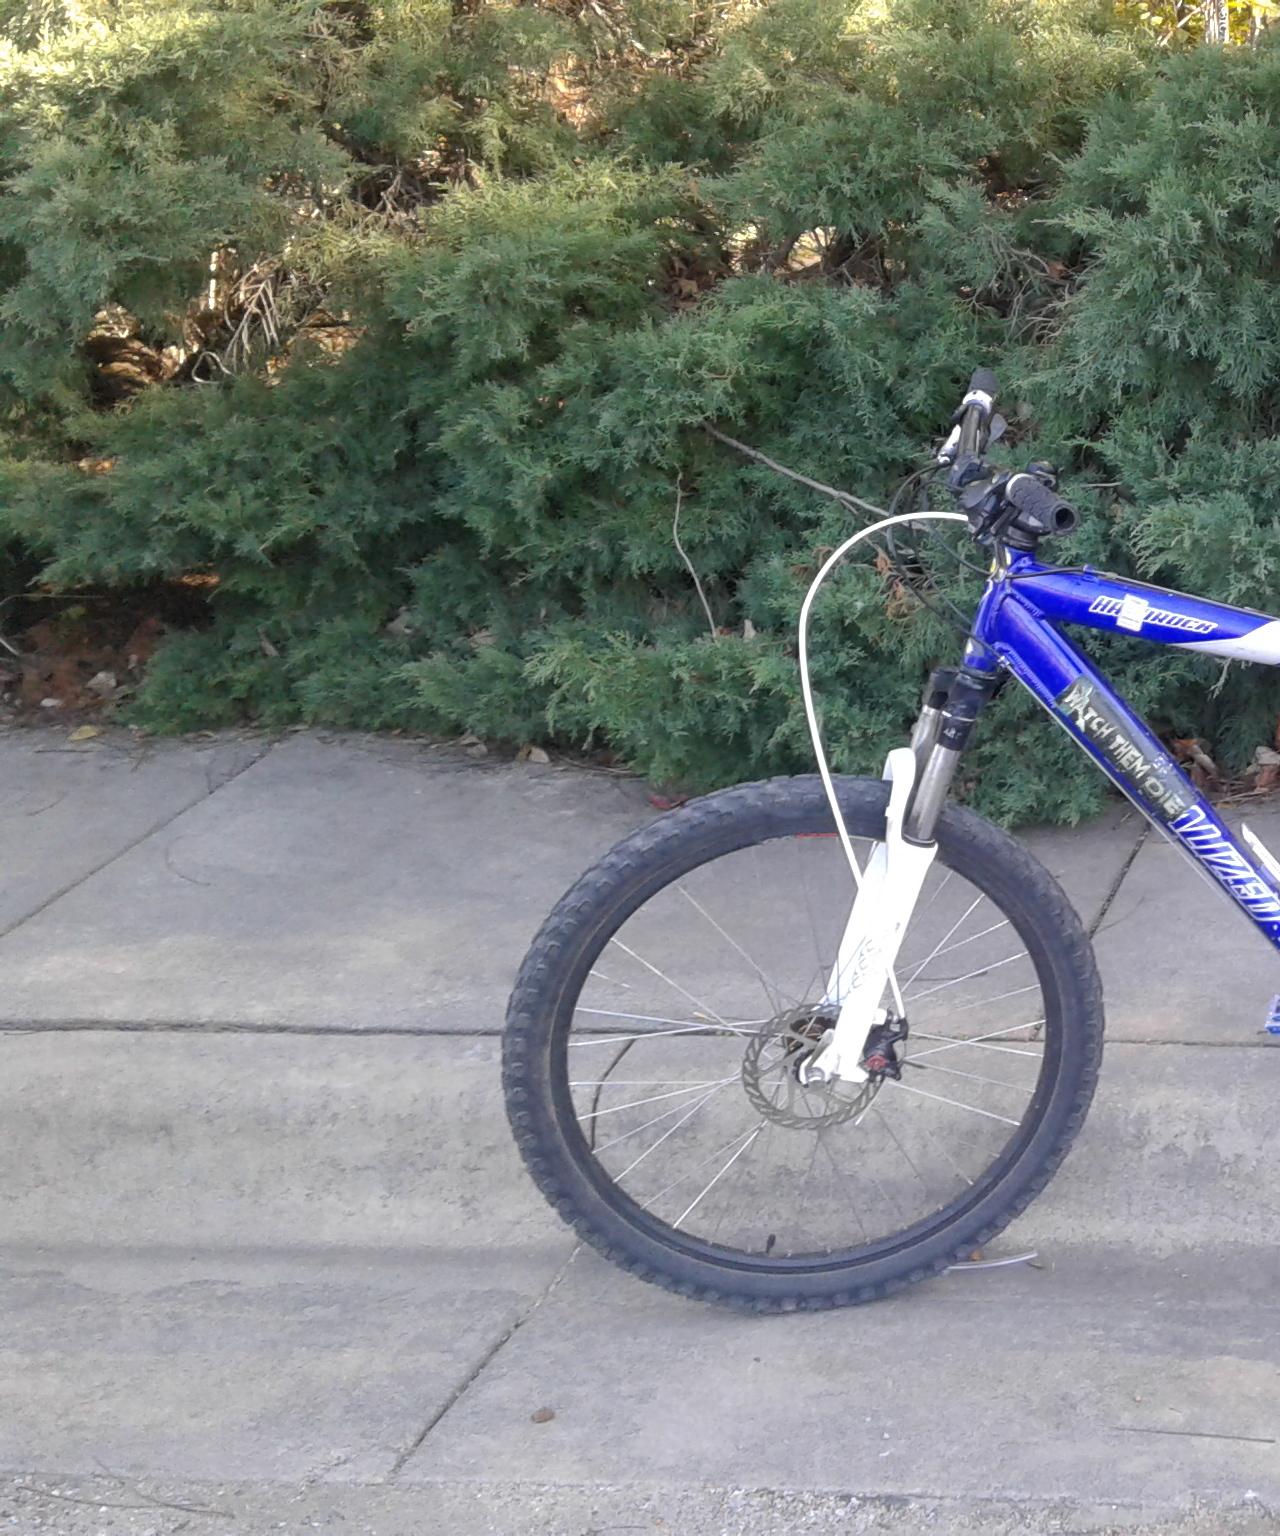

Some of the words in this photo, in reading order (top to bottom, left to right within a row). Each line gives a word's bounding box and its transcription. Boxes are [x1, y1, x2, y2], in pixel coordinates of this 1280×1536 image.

[1064, 685, 1116, 738] WATCH
[1109, 734, 1151, 779] THEM
[1145, 777, 1186, 817] DIE
